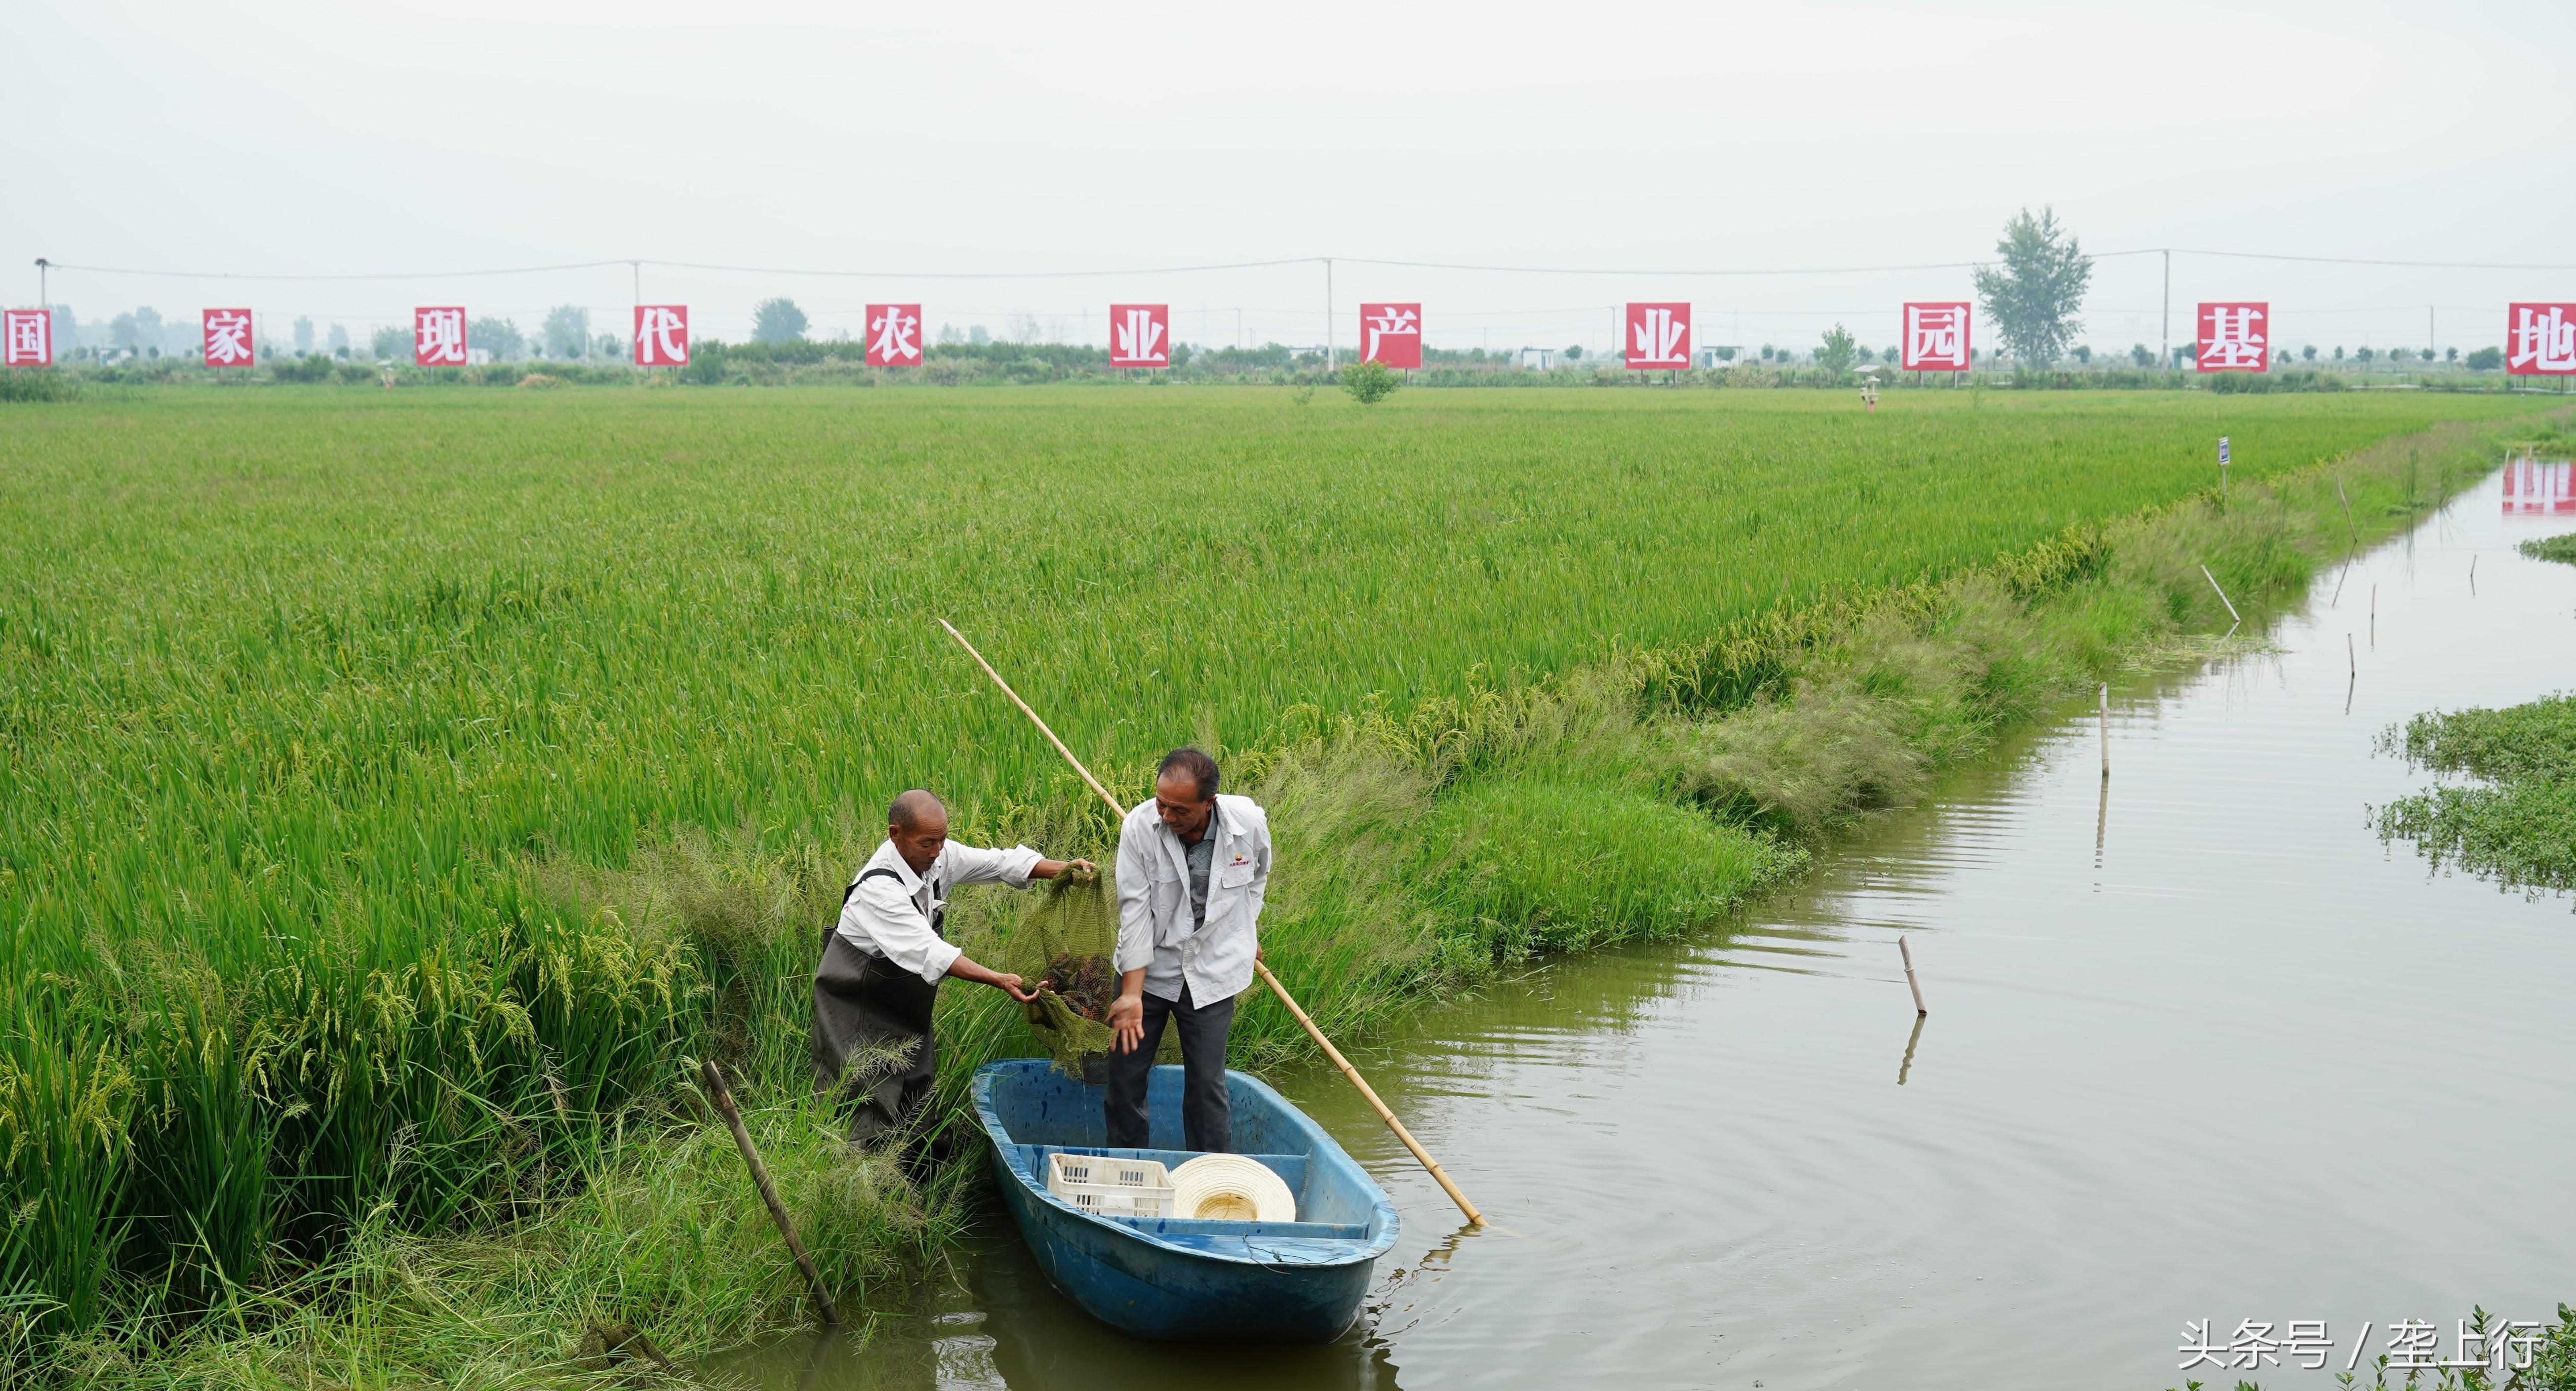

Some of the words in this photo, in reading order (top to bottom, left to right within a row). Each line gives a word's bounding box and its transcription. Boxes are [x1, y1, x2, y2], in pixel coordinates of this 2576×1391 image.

[7, 312, 47, 363] 国
[206, 311, 250, 363] 家
[417, 309, 463, 362] 现
[636, 308, 685, 363] 代
[869, 307, 919, 362] 农
[1112, 310, 1166, 361] 业
[1364, 307, 1418, 364] 产
[1628, 309, 1687, 362] 业
[1907, 305, 1967, 366] 园
[2200, 307, 2265, 368] 基
[2511, 307, 2576, 370] 地
